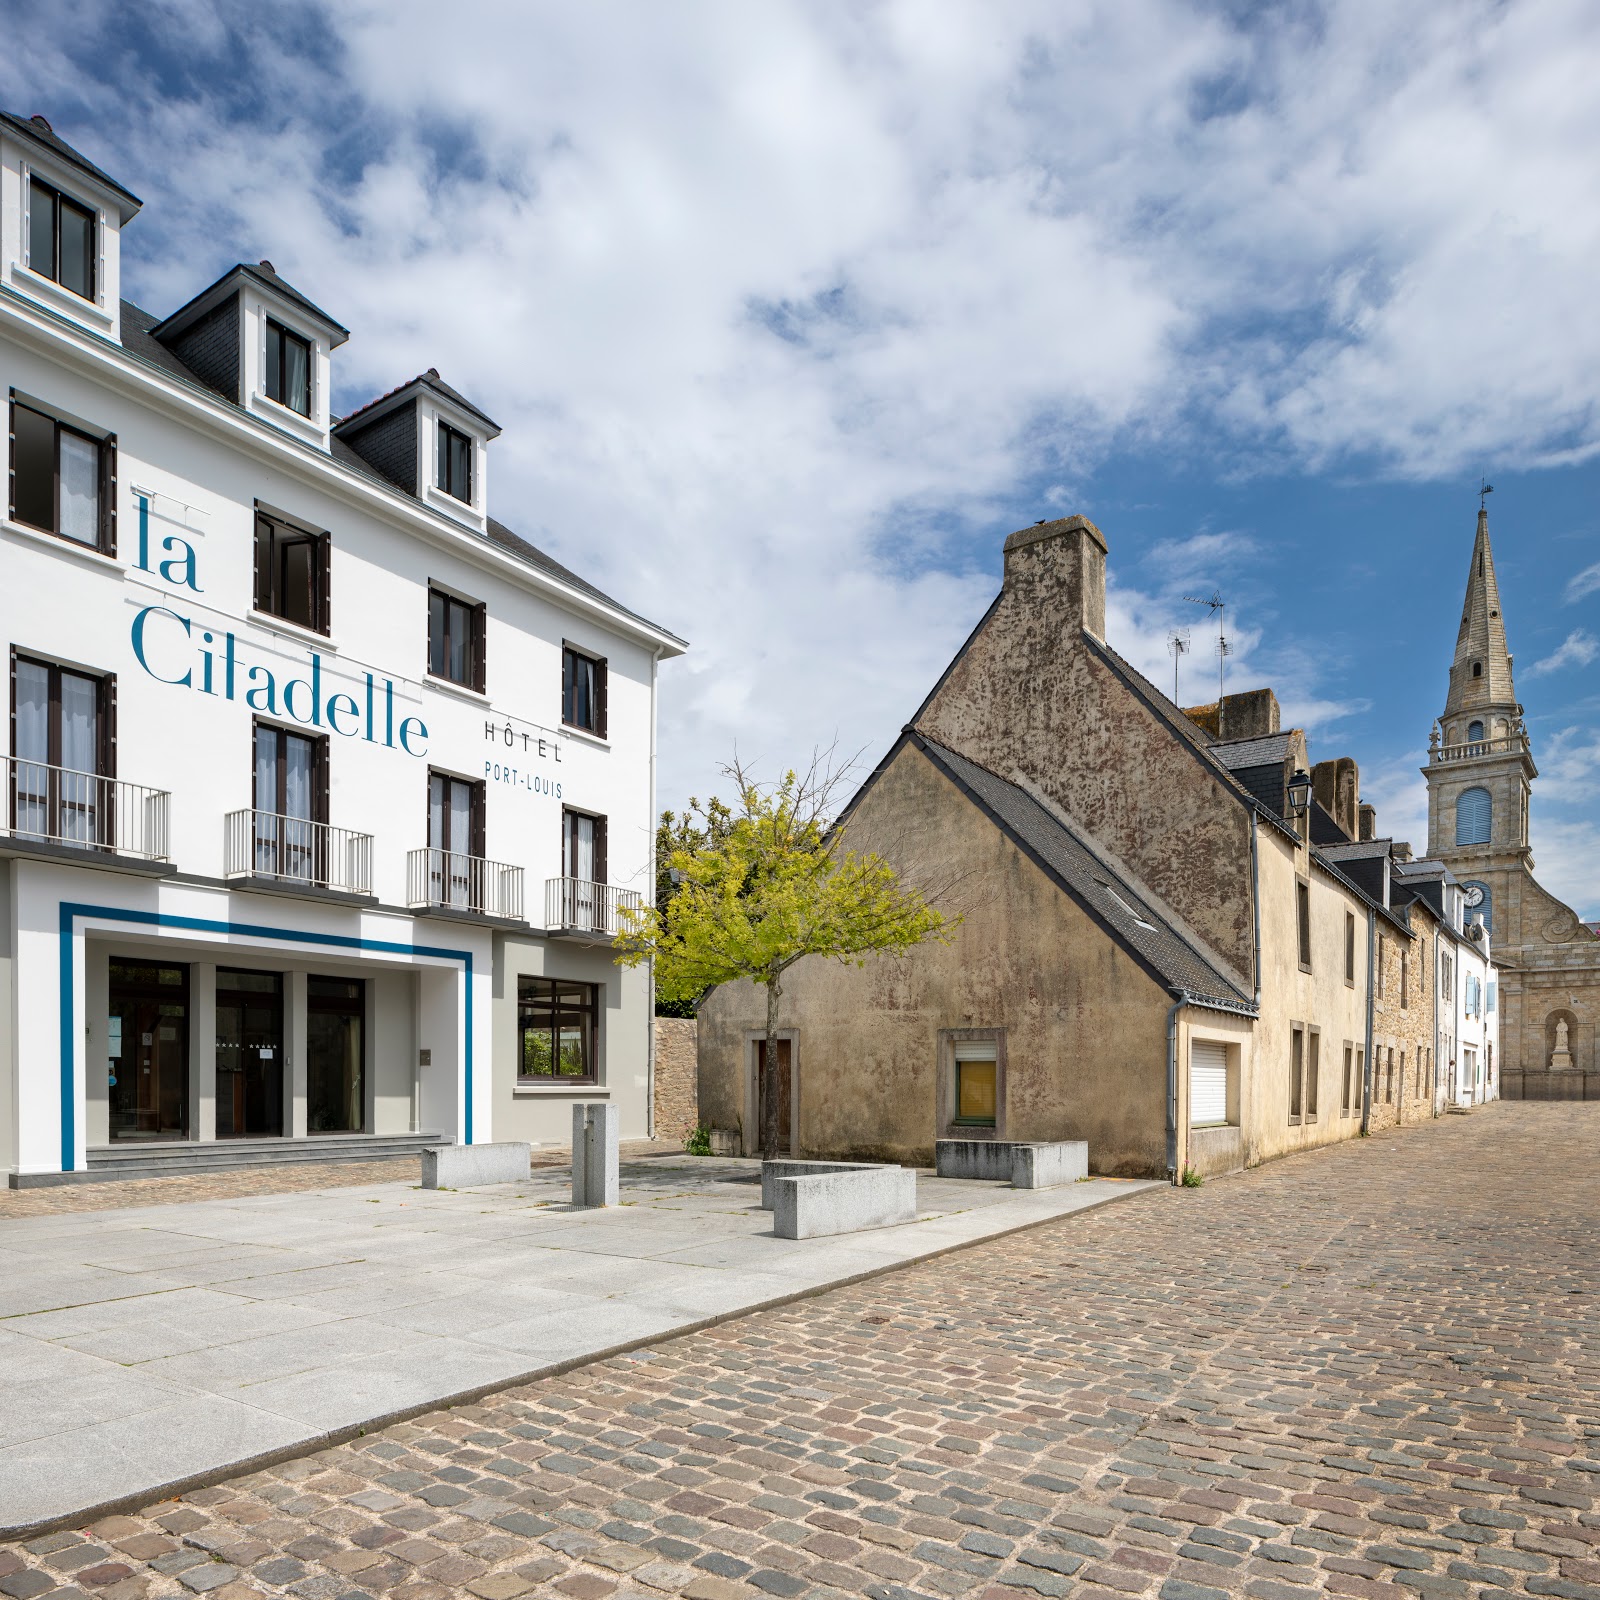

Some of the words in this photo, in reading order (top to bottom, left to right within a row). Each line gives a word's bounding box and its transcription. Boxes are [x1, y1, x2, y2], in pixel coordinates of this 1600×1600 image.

[131, 492, 204, 592] la
[131, 606, 429, 757] Citadelle
[485, 721, 561, 762] HÔTEL
[485, 761, 562, 799] PORT-LOUIS
